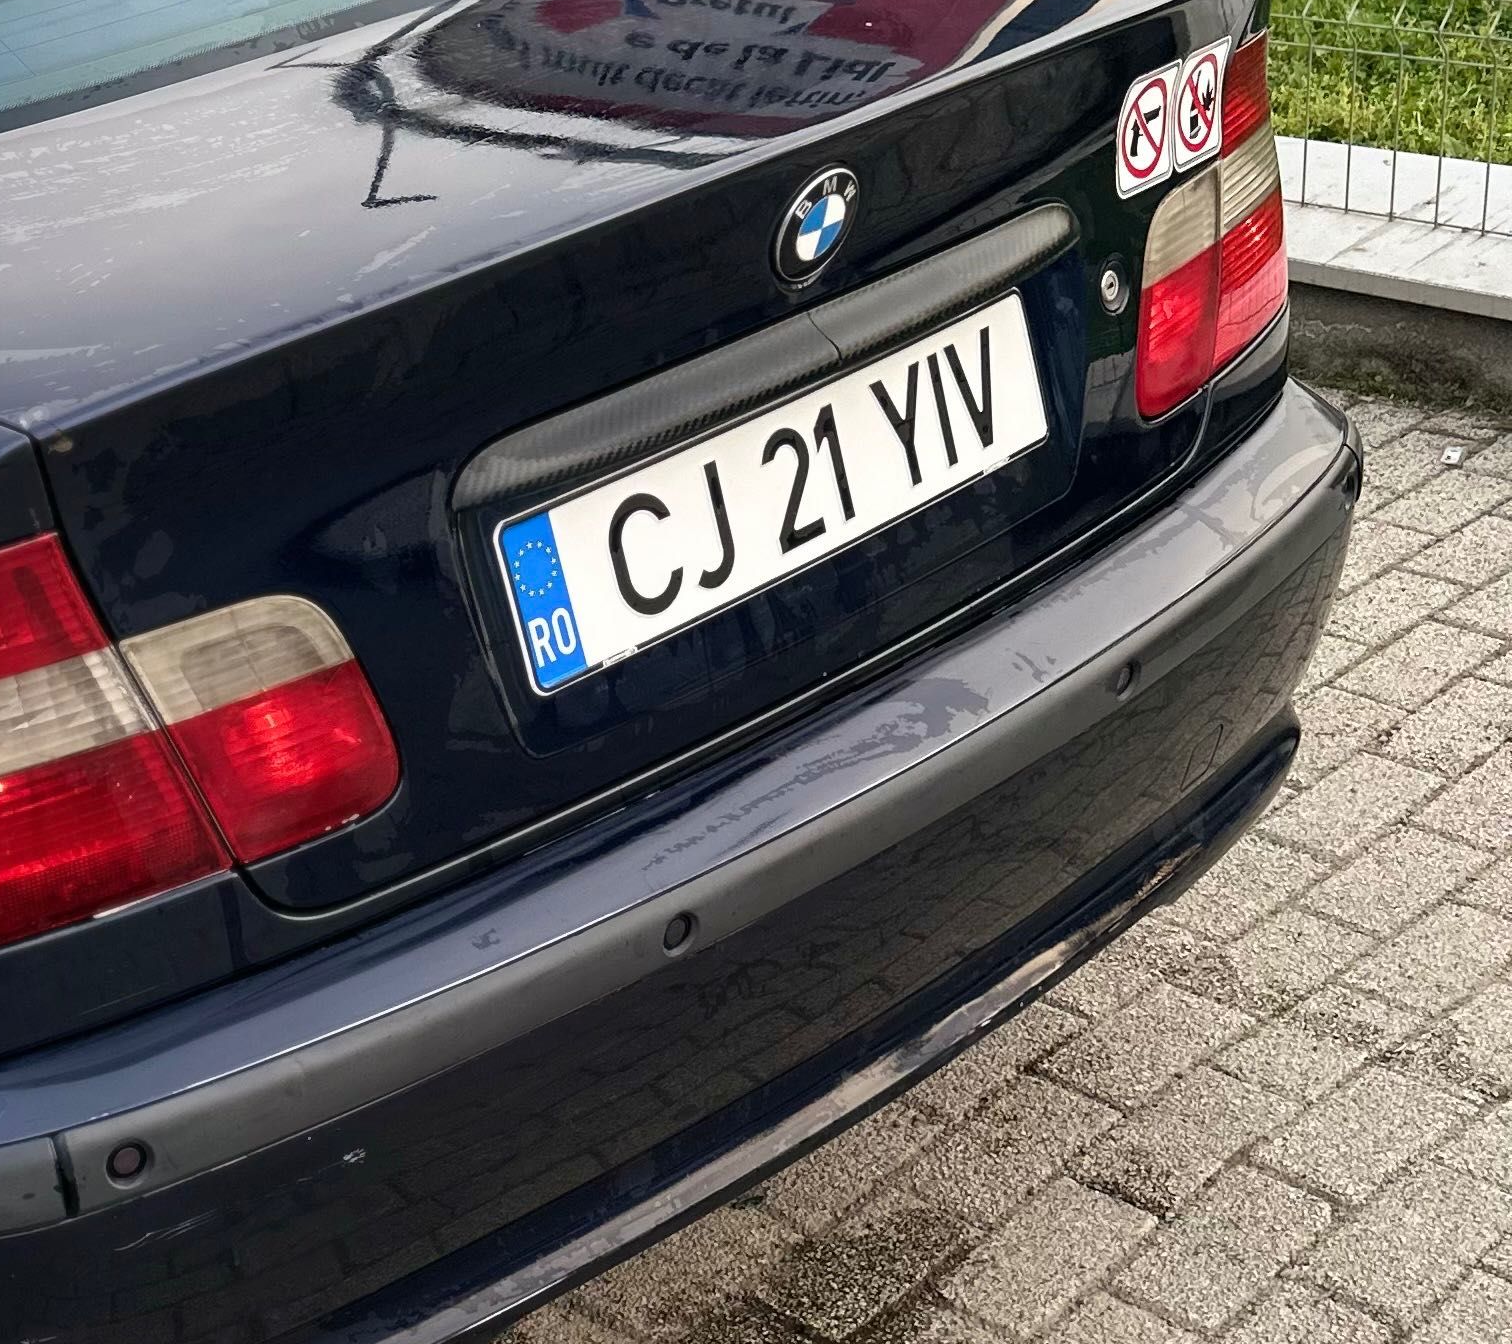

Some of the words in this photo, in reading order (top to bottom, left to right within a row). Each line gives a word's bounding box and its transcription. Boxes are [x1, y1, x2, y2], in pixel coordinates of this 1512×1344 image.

[795, 175, 857, 219] BMW
[608, 460, 735, 616] CJ
[761, 403, 857, 554] 21
[869, 325, 994, 487] YIV
[527, 606, 578, 669] RO
